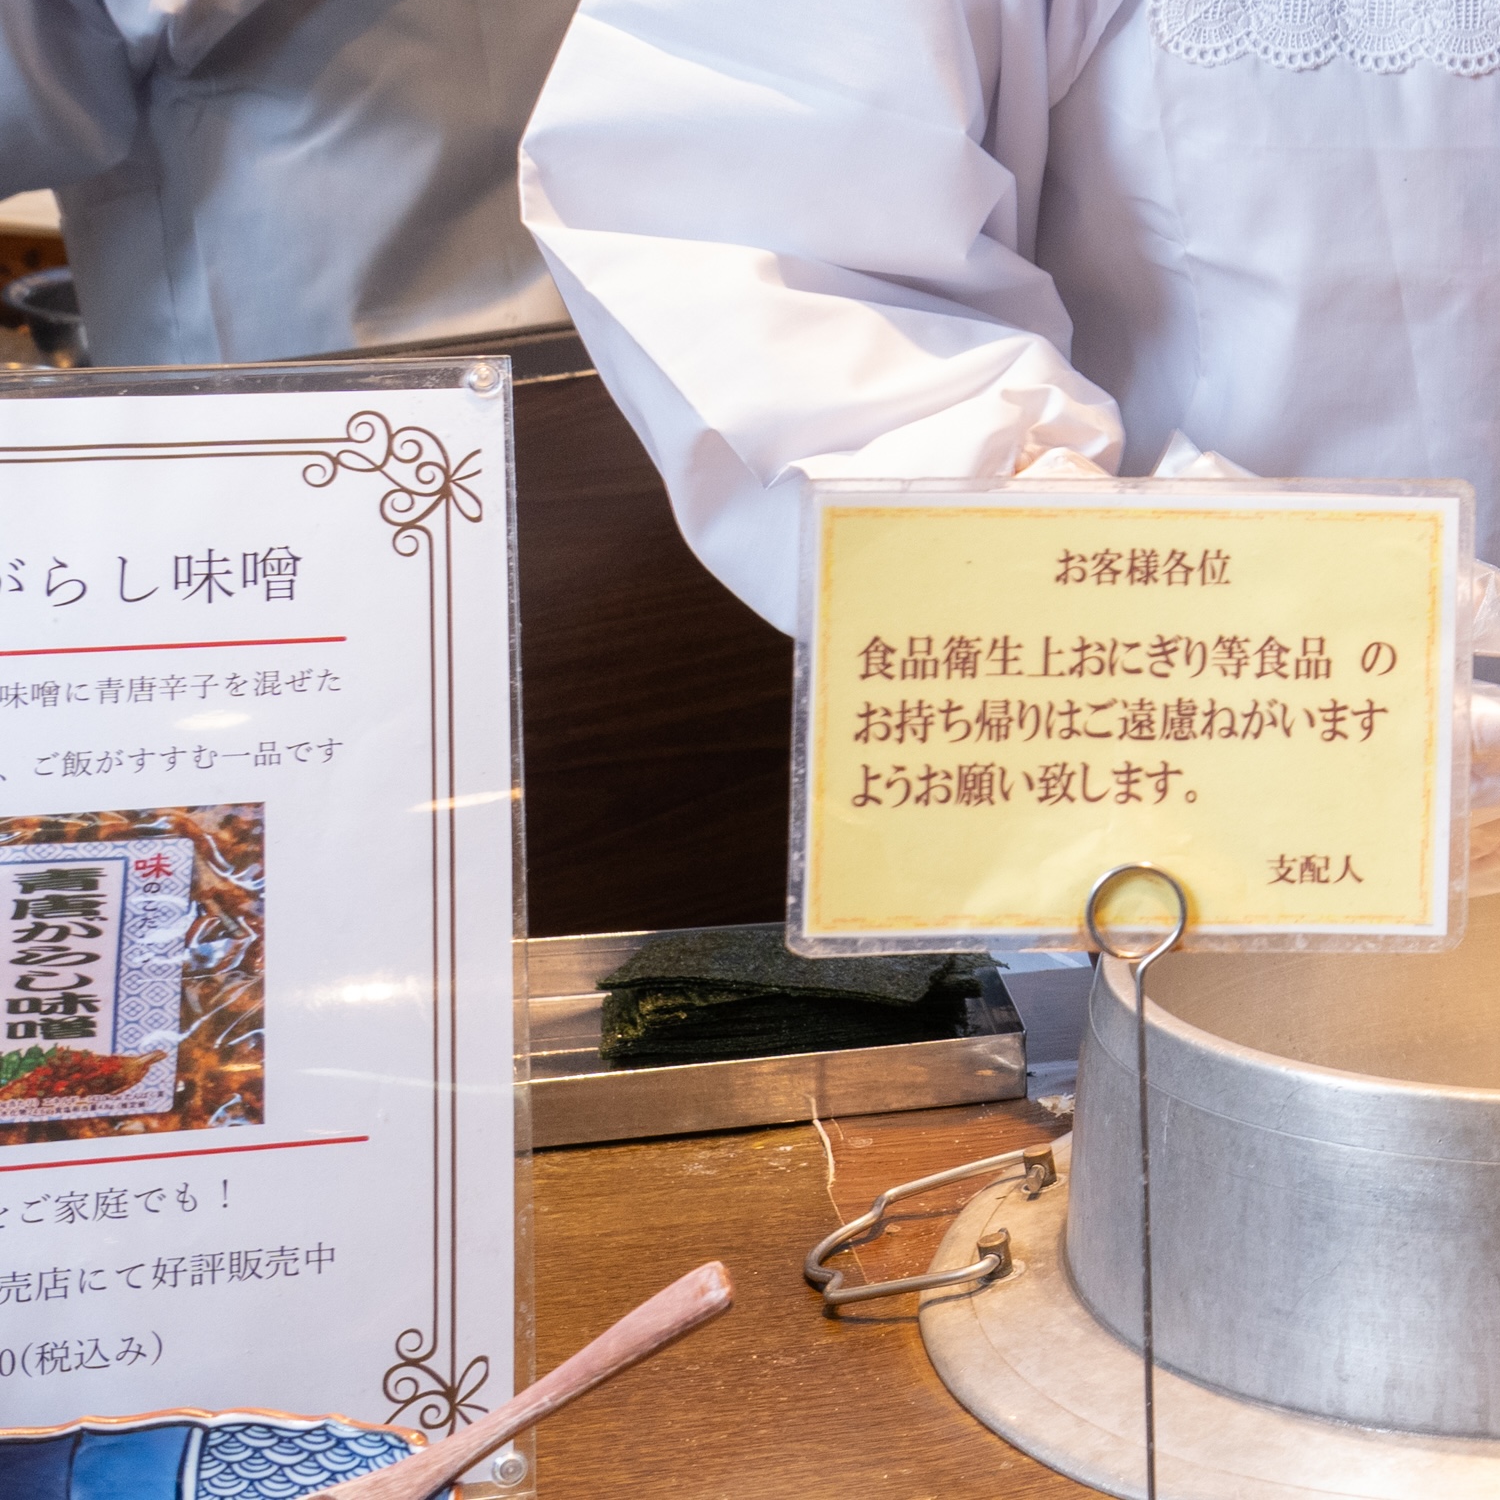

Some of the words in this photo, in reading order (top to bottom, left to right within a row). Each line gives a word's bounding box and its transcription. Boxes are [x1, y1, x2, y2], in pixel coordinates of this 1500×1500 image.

[1054, 547, 1232, 587] お客様各位
[857, 633, 1332, 681] 食品衛生上おにぎり等食品
[1360, 641, 1398, 676] の
[0, 668, 342, 709] 味噌に青唐辛子を混ぜた
[853, 696, 1389, 745] お持ち帰りはご遠慮ねがいます
[851, 760, 1198, 808] ようお願い致します。
[1268, 853, 1364, 885] 支配人
[7, 867, 108, 1040] 青唐がらし味噌
[0, 1241, 337, 1305] 売店にて好評販売中
